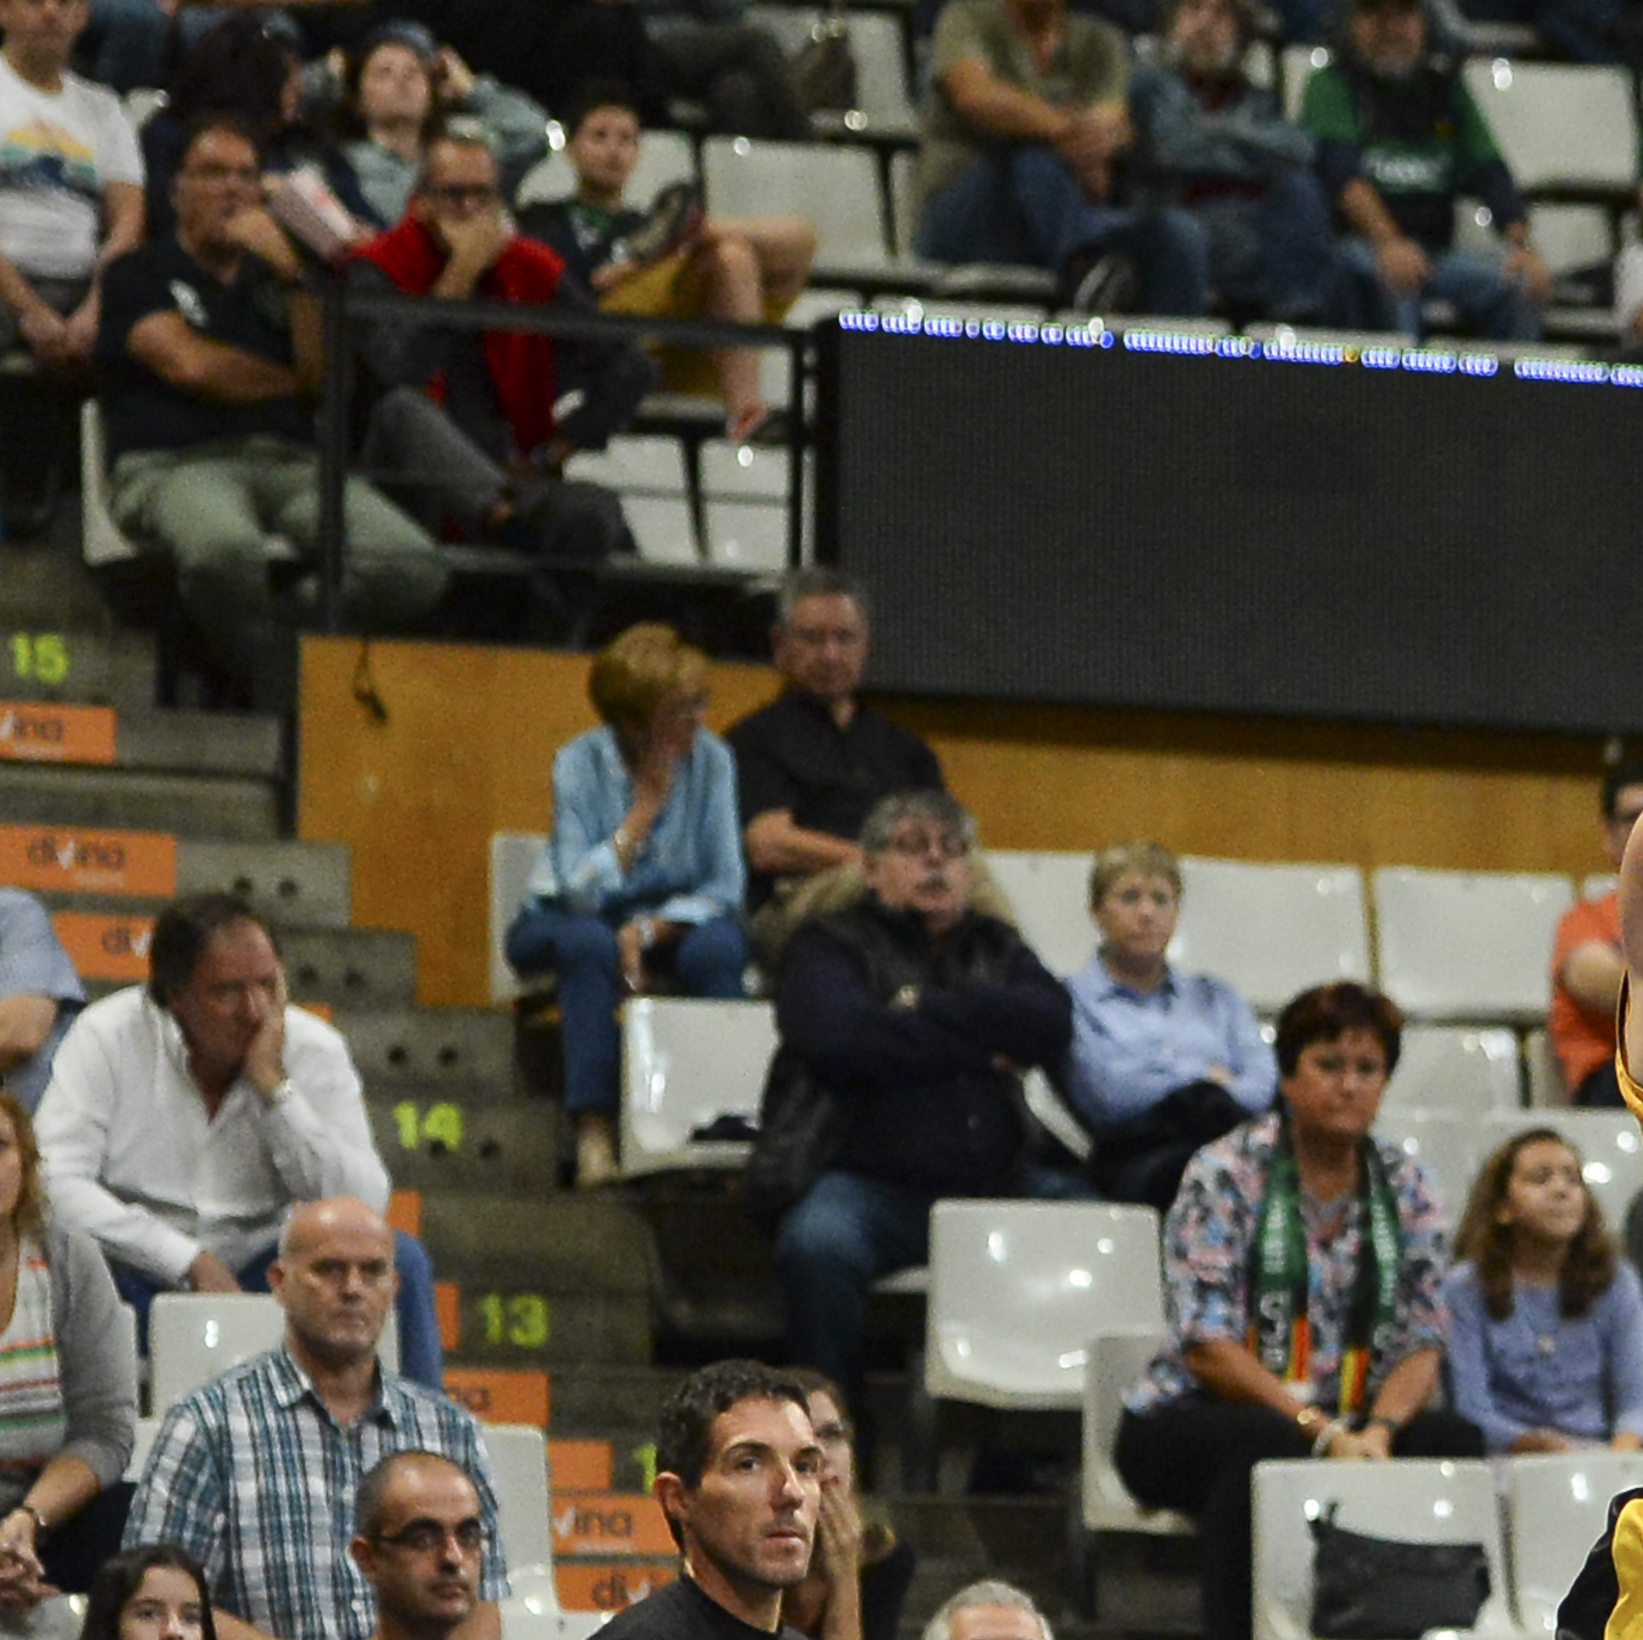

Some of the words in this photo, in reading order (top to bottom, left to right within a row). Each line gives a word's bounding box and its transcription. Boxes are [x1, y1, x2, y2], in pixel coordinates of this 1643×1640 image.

[12, 633, 68, 684] 15
[394, 1102, 462, 1150] 14
[483, 1295, 548, 1349] 13
